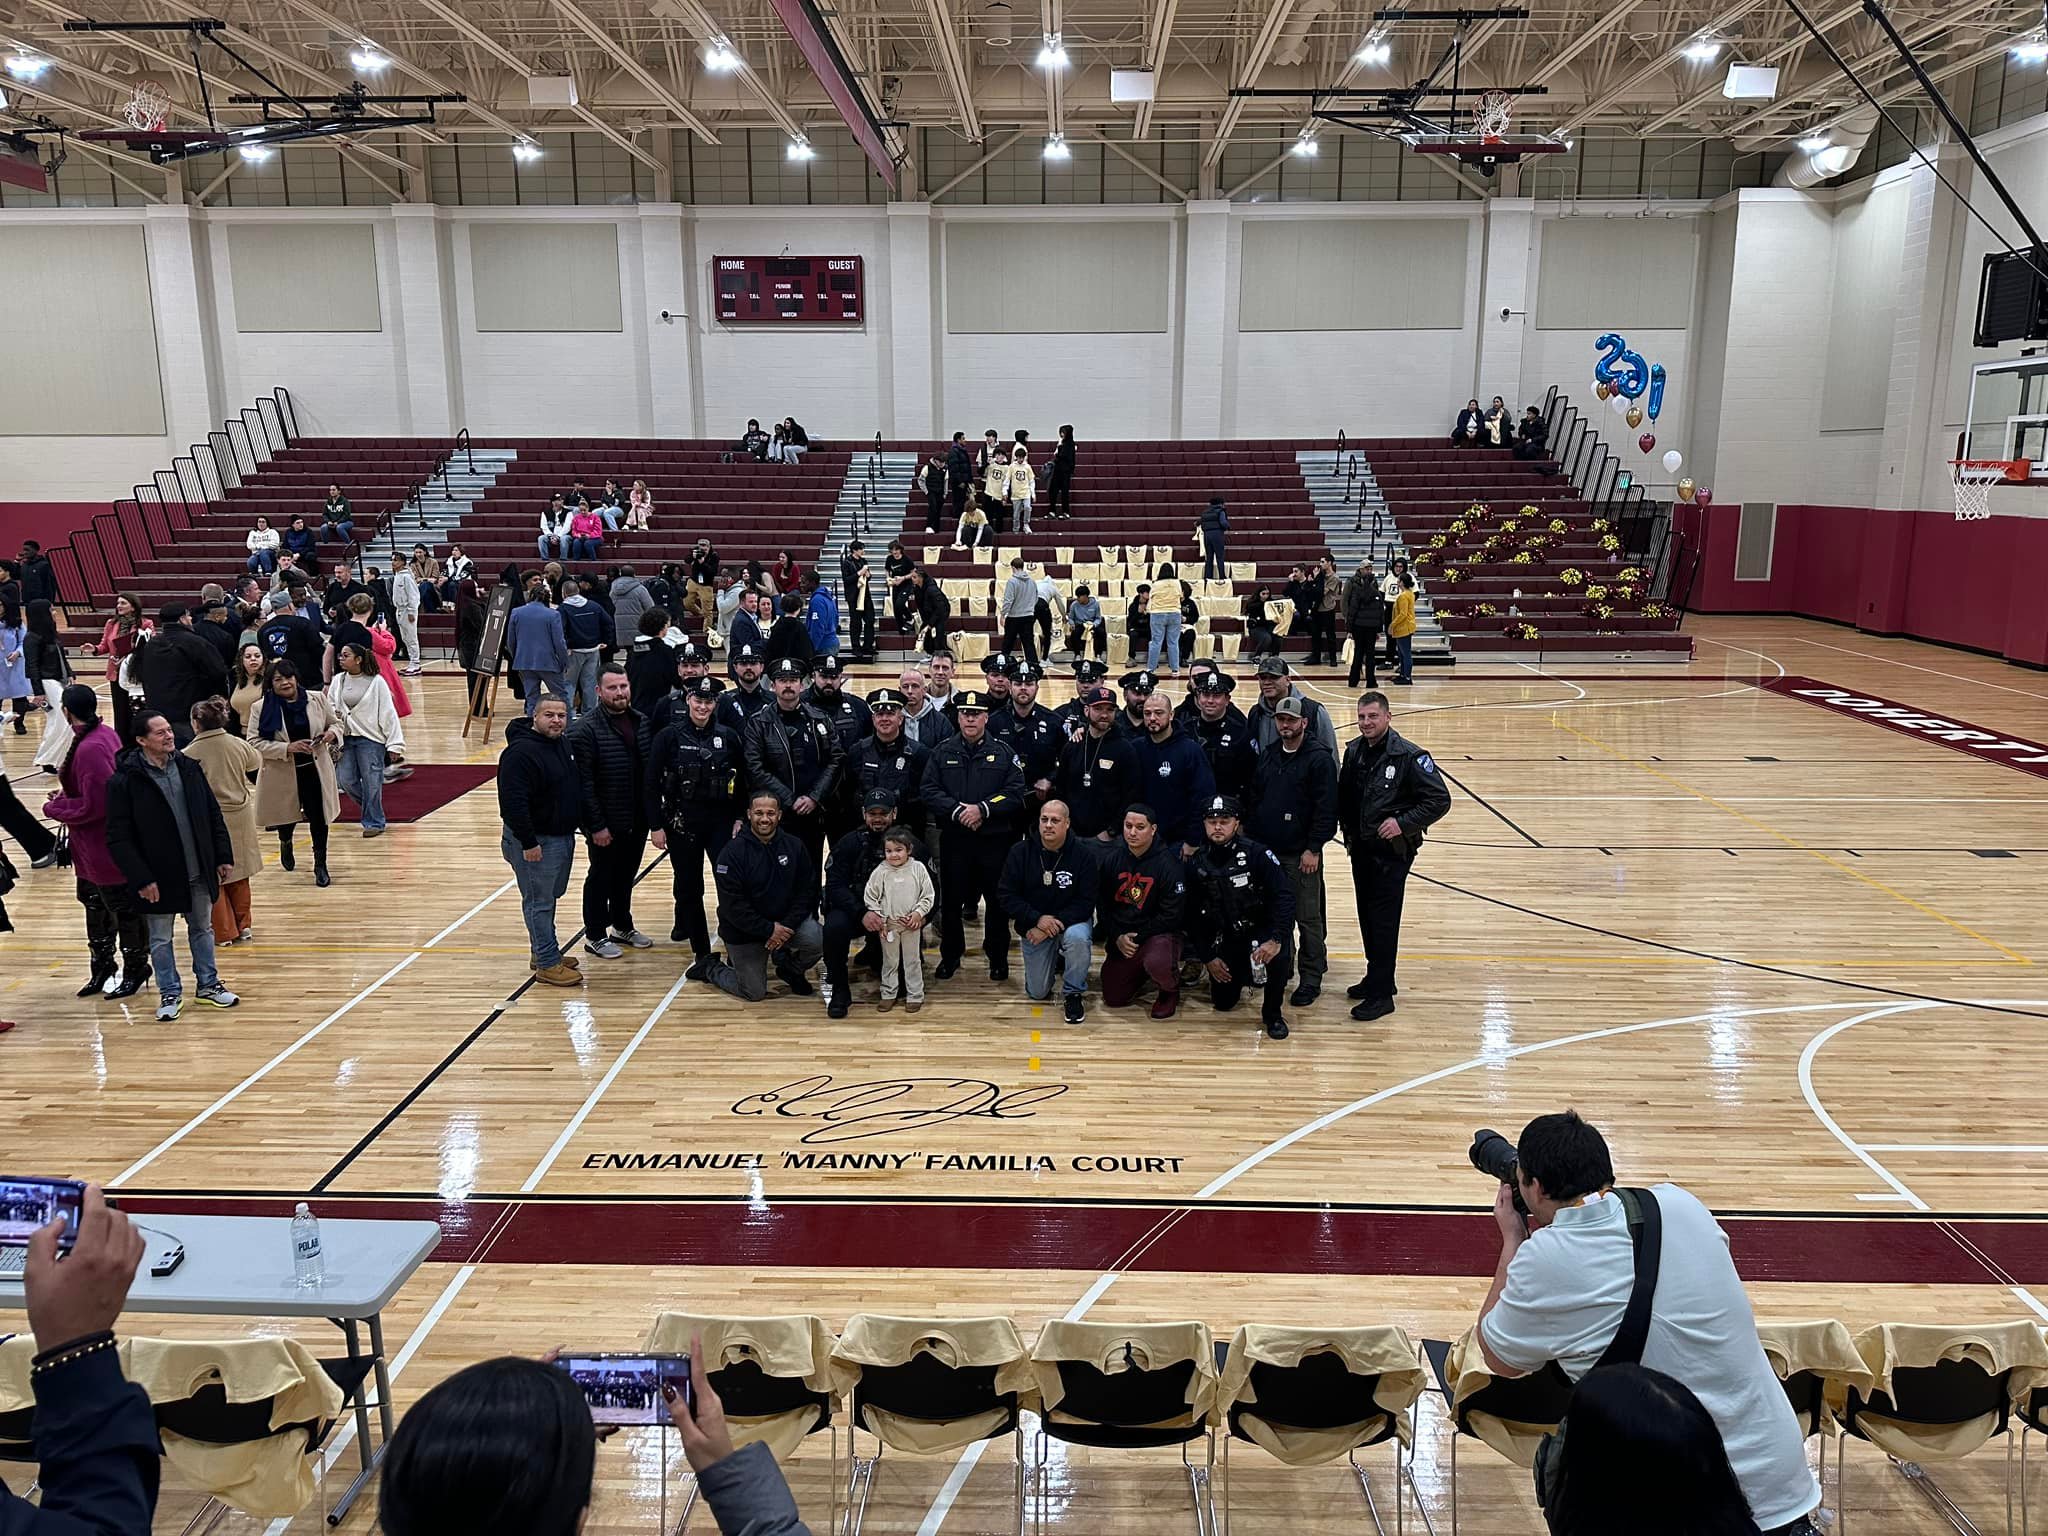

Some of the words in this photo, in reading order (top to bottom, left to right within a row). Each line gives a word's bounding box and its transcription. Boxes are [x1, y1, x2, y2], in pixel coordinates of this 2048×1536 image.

[720, 260, 745, 270] HOME
[828, 260, 856, 270] GUEST
[581, 1153, 769, 1169] ENMANUEL
[925, 1154, 1057, 1171] FAMILIA
[1071, 1156, 1185, 1173] COURT
